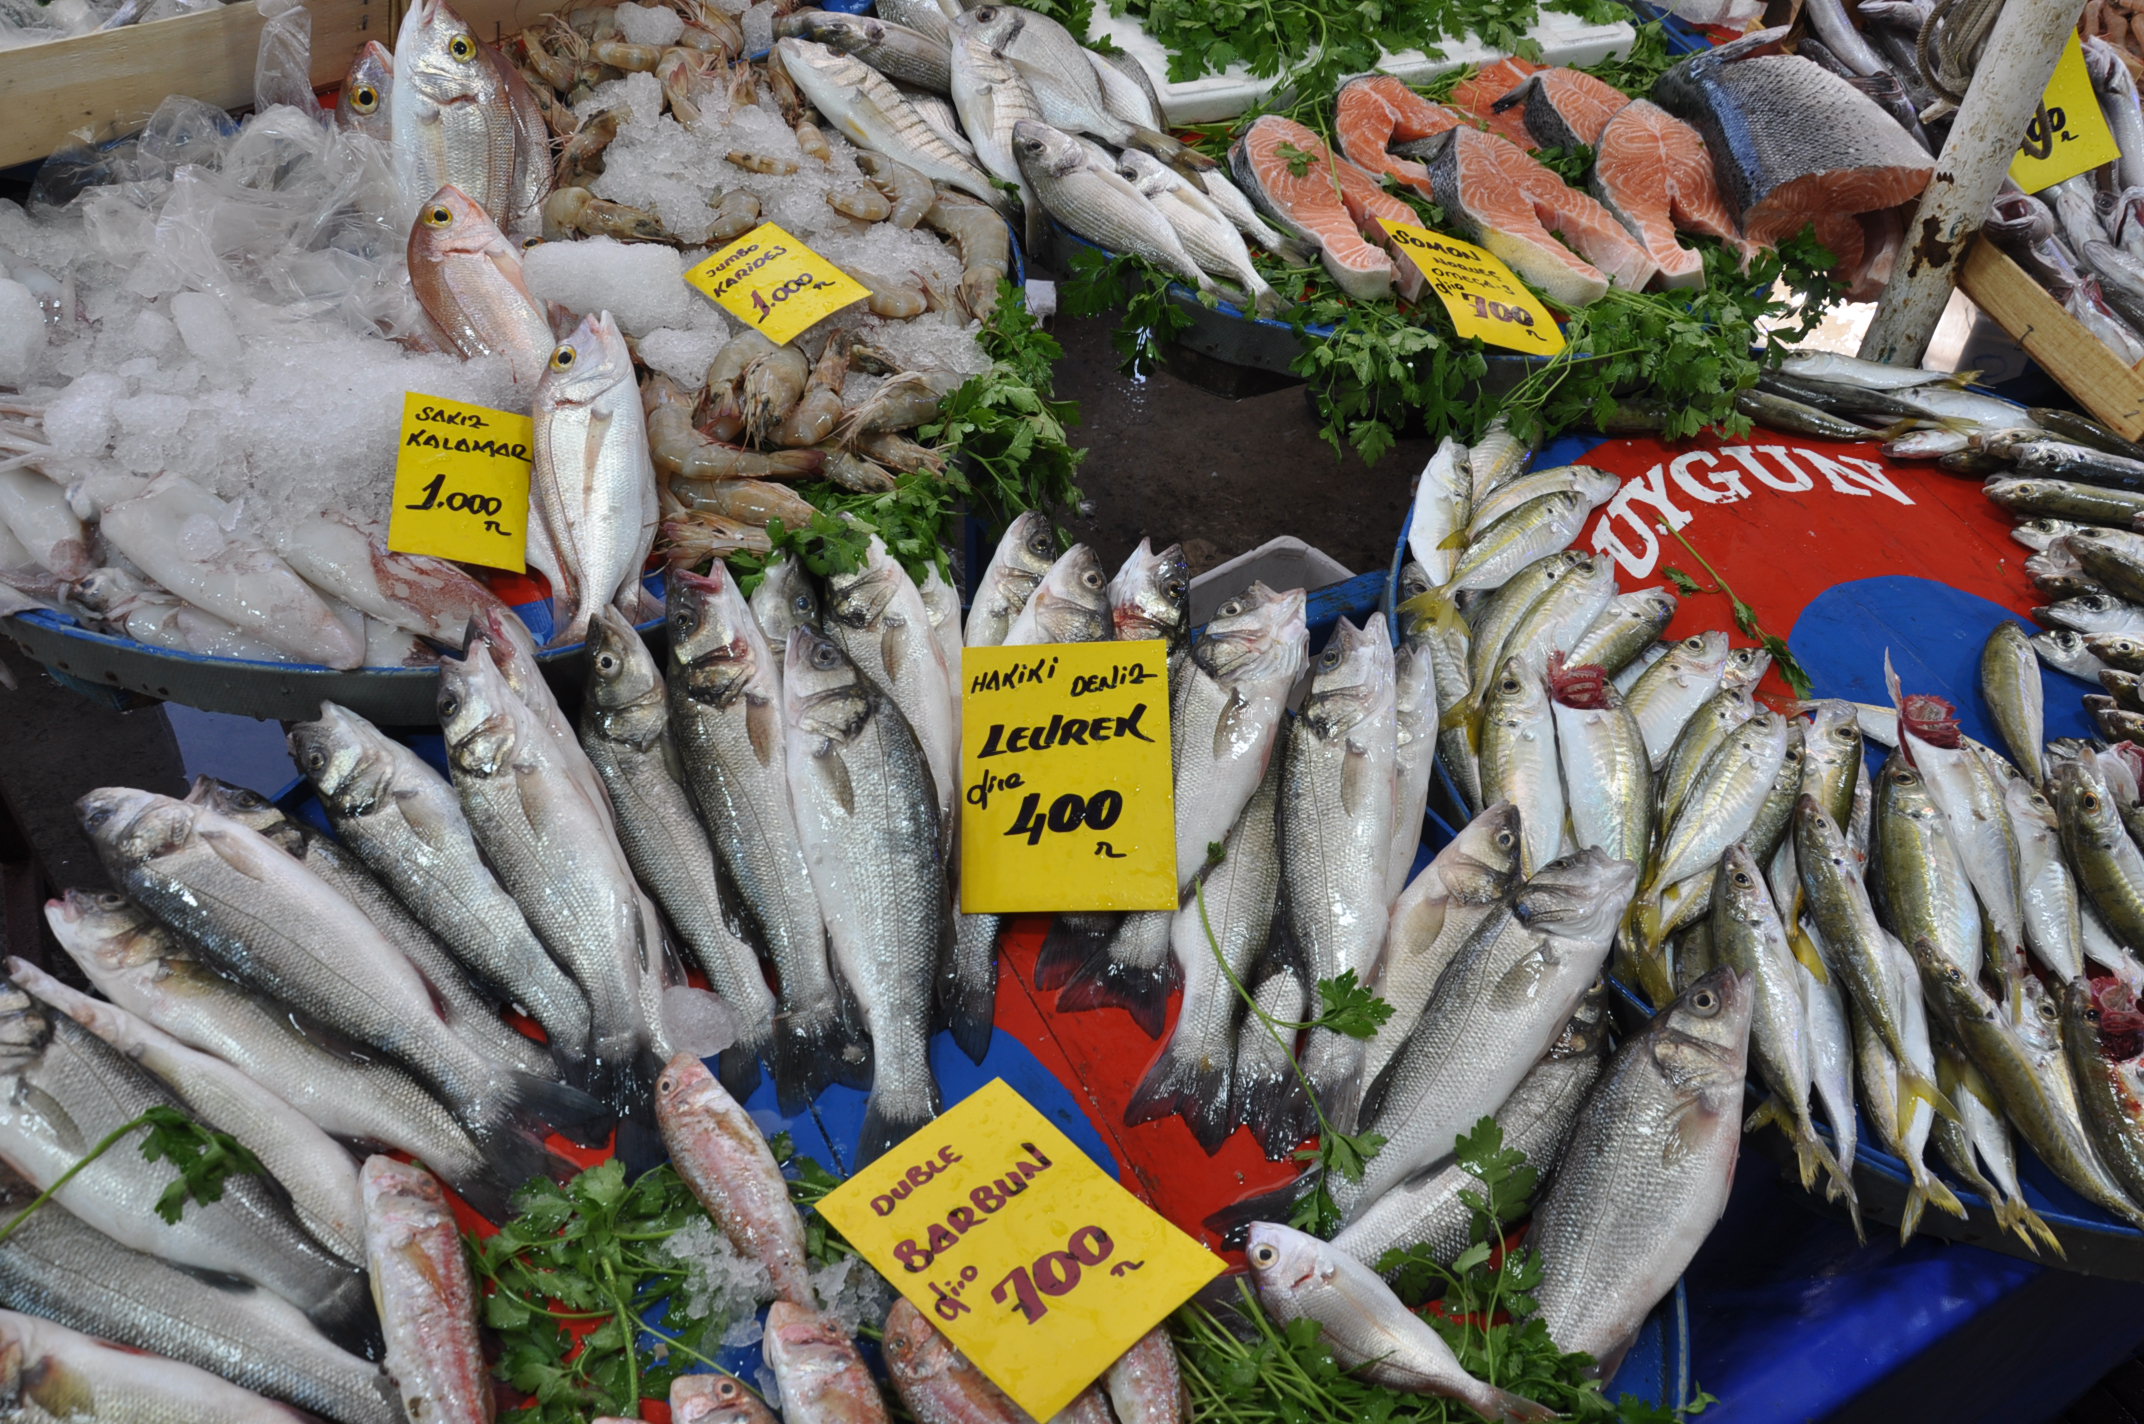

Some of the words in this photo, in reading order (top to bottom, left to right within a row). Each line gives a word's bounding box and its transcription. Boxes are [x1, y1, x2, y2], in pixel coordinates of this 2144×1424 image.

[705, 244, 760, 278] JUMBO
[1391, 229, 1482, 262] SOMON
[751, 273, 813, 324] 1.000
[1461, 291, 1535, 328] 700
[405, 429, 533, 463] KALAMAR
[405, 473, 503, 517] 1.000
[1591, 445, 1916, 579] UYGUN
[1003, 789, 1124, 847] 400
[869, 1144, 964, 1218] DUBLE
[892, 1141, 1054, 1273] BARBUN
[990, 1224, 1115, 1326] 700
